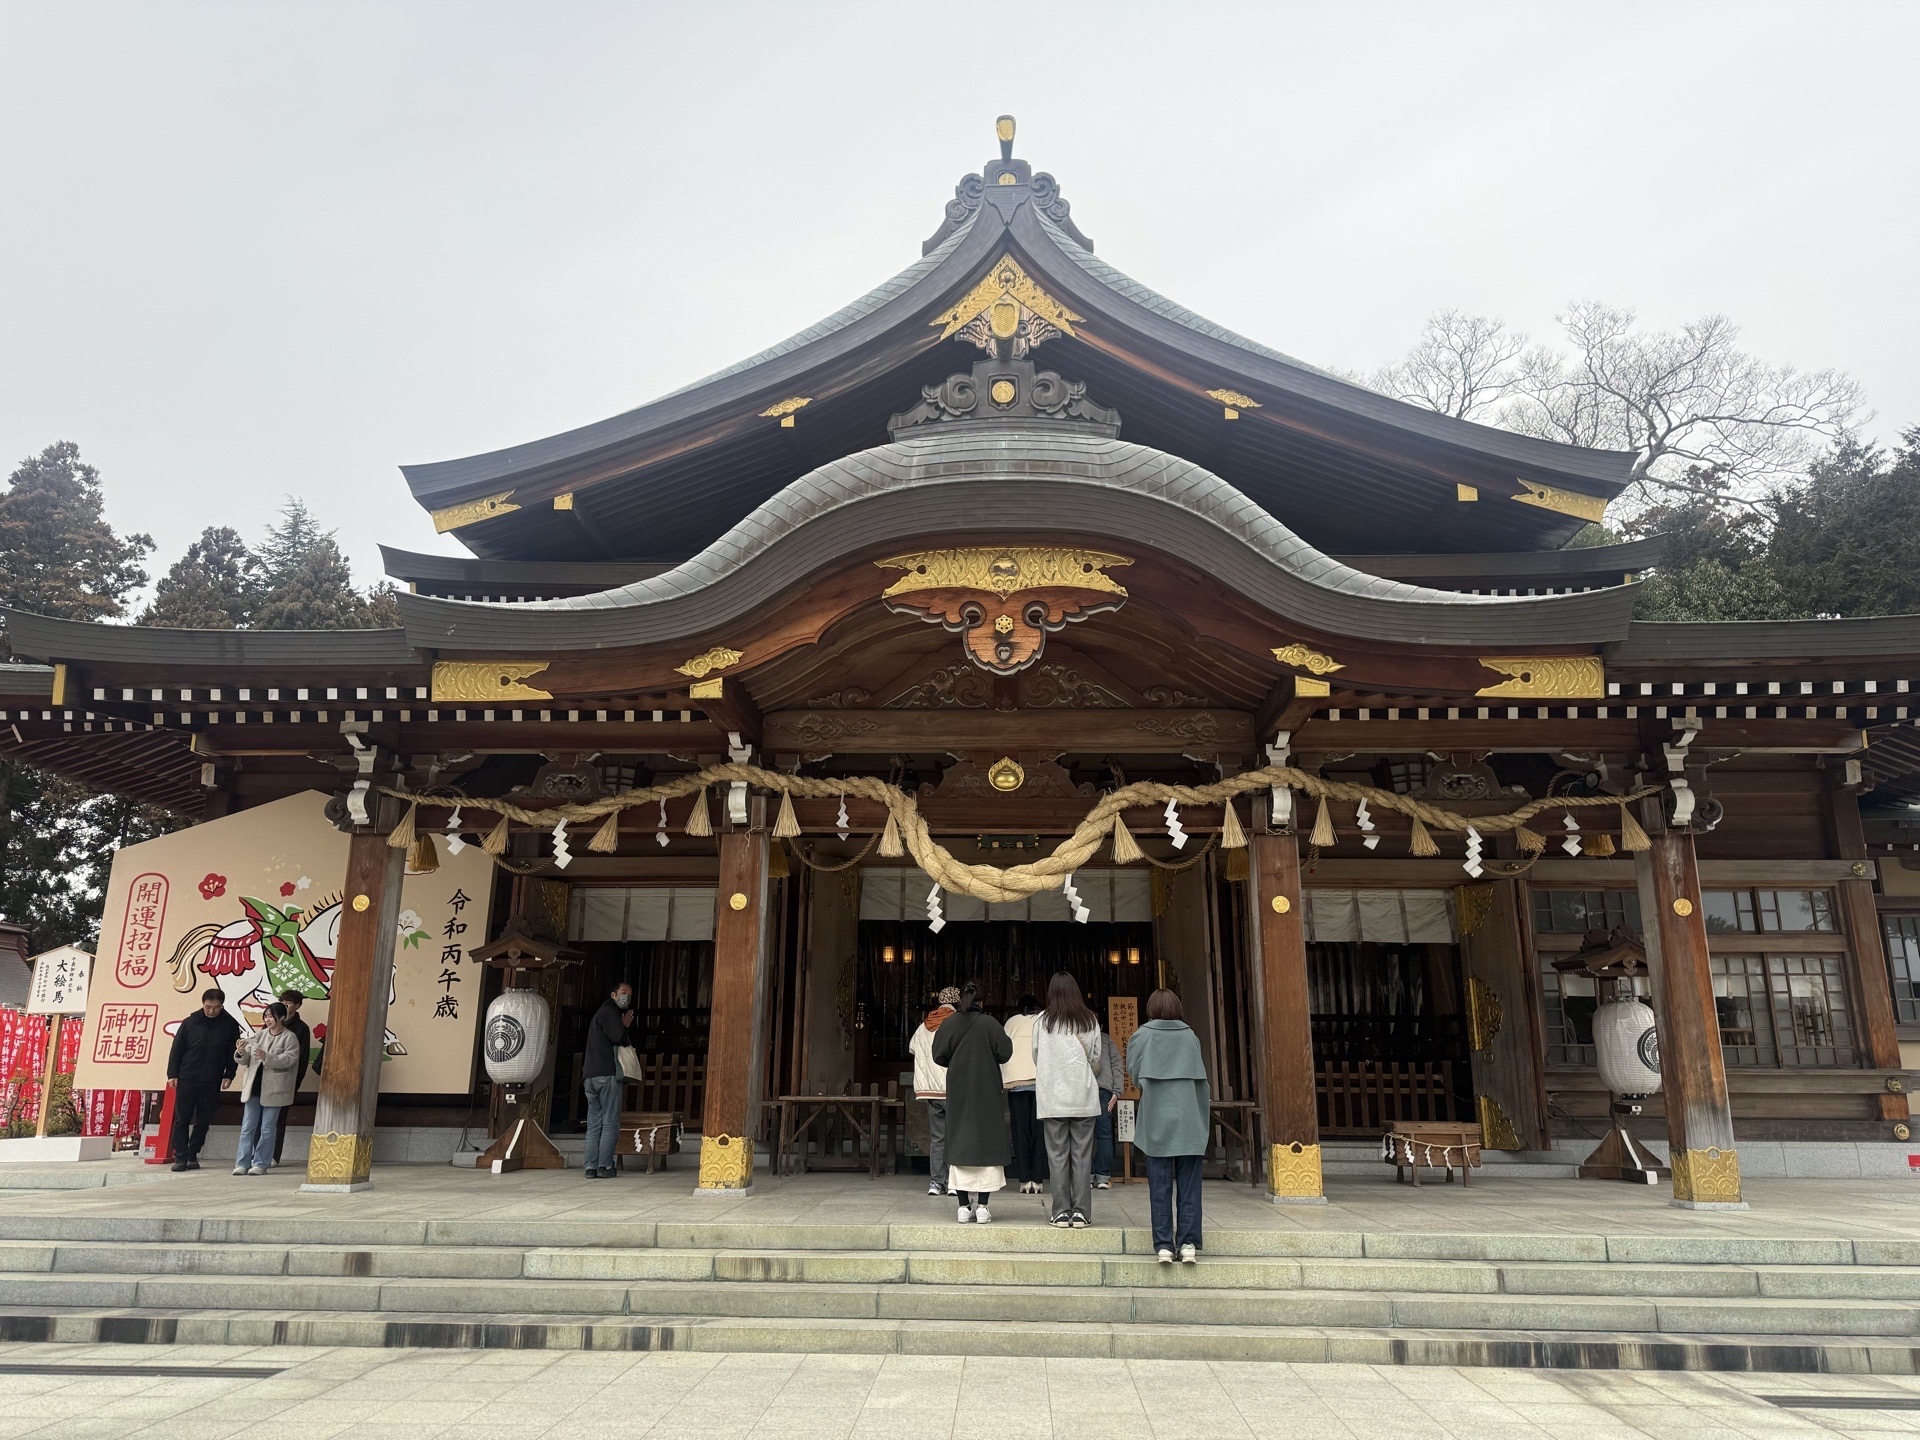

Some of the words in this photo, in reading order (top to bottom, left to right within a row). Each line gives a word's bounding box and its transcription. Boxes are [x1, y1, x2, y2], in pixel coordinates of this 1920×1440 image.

[120, 881, 162, 977] 開運招福
[432, 889, 473, 1020] 令和丙午歳
[52, 959, 68, 1004] 大絵馬
[97, 1008, 128, 1059] 神社
[122, 1008, 153, 1060] 竹駒
